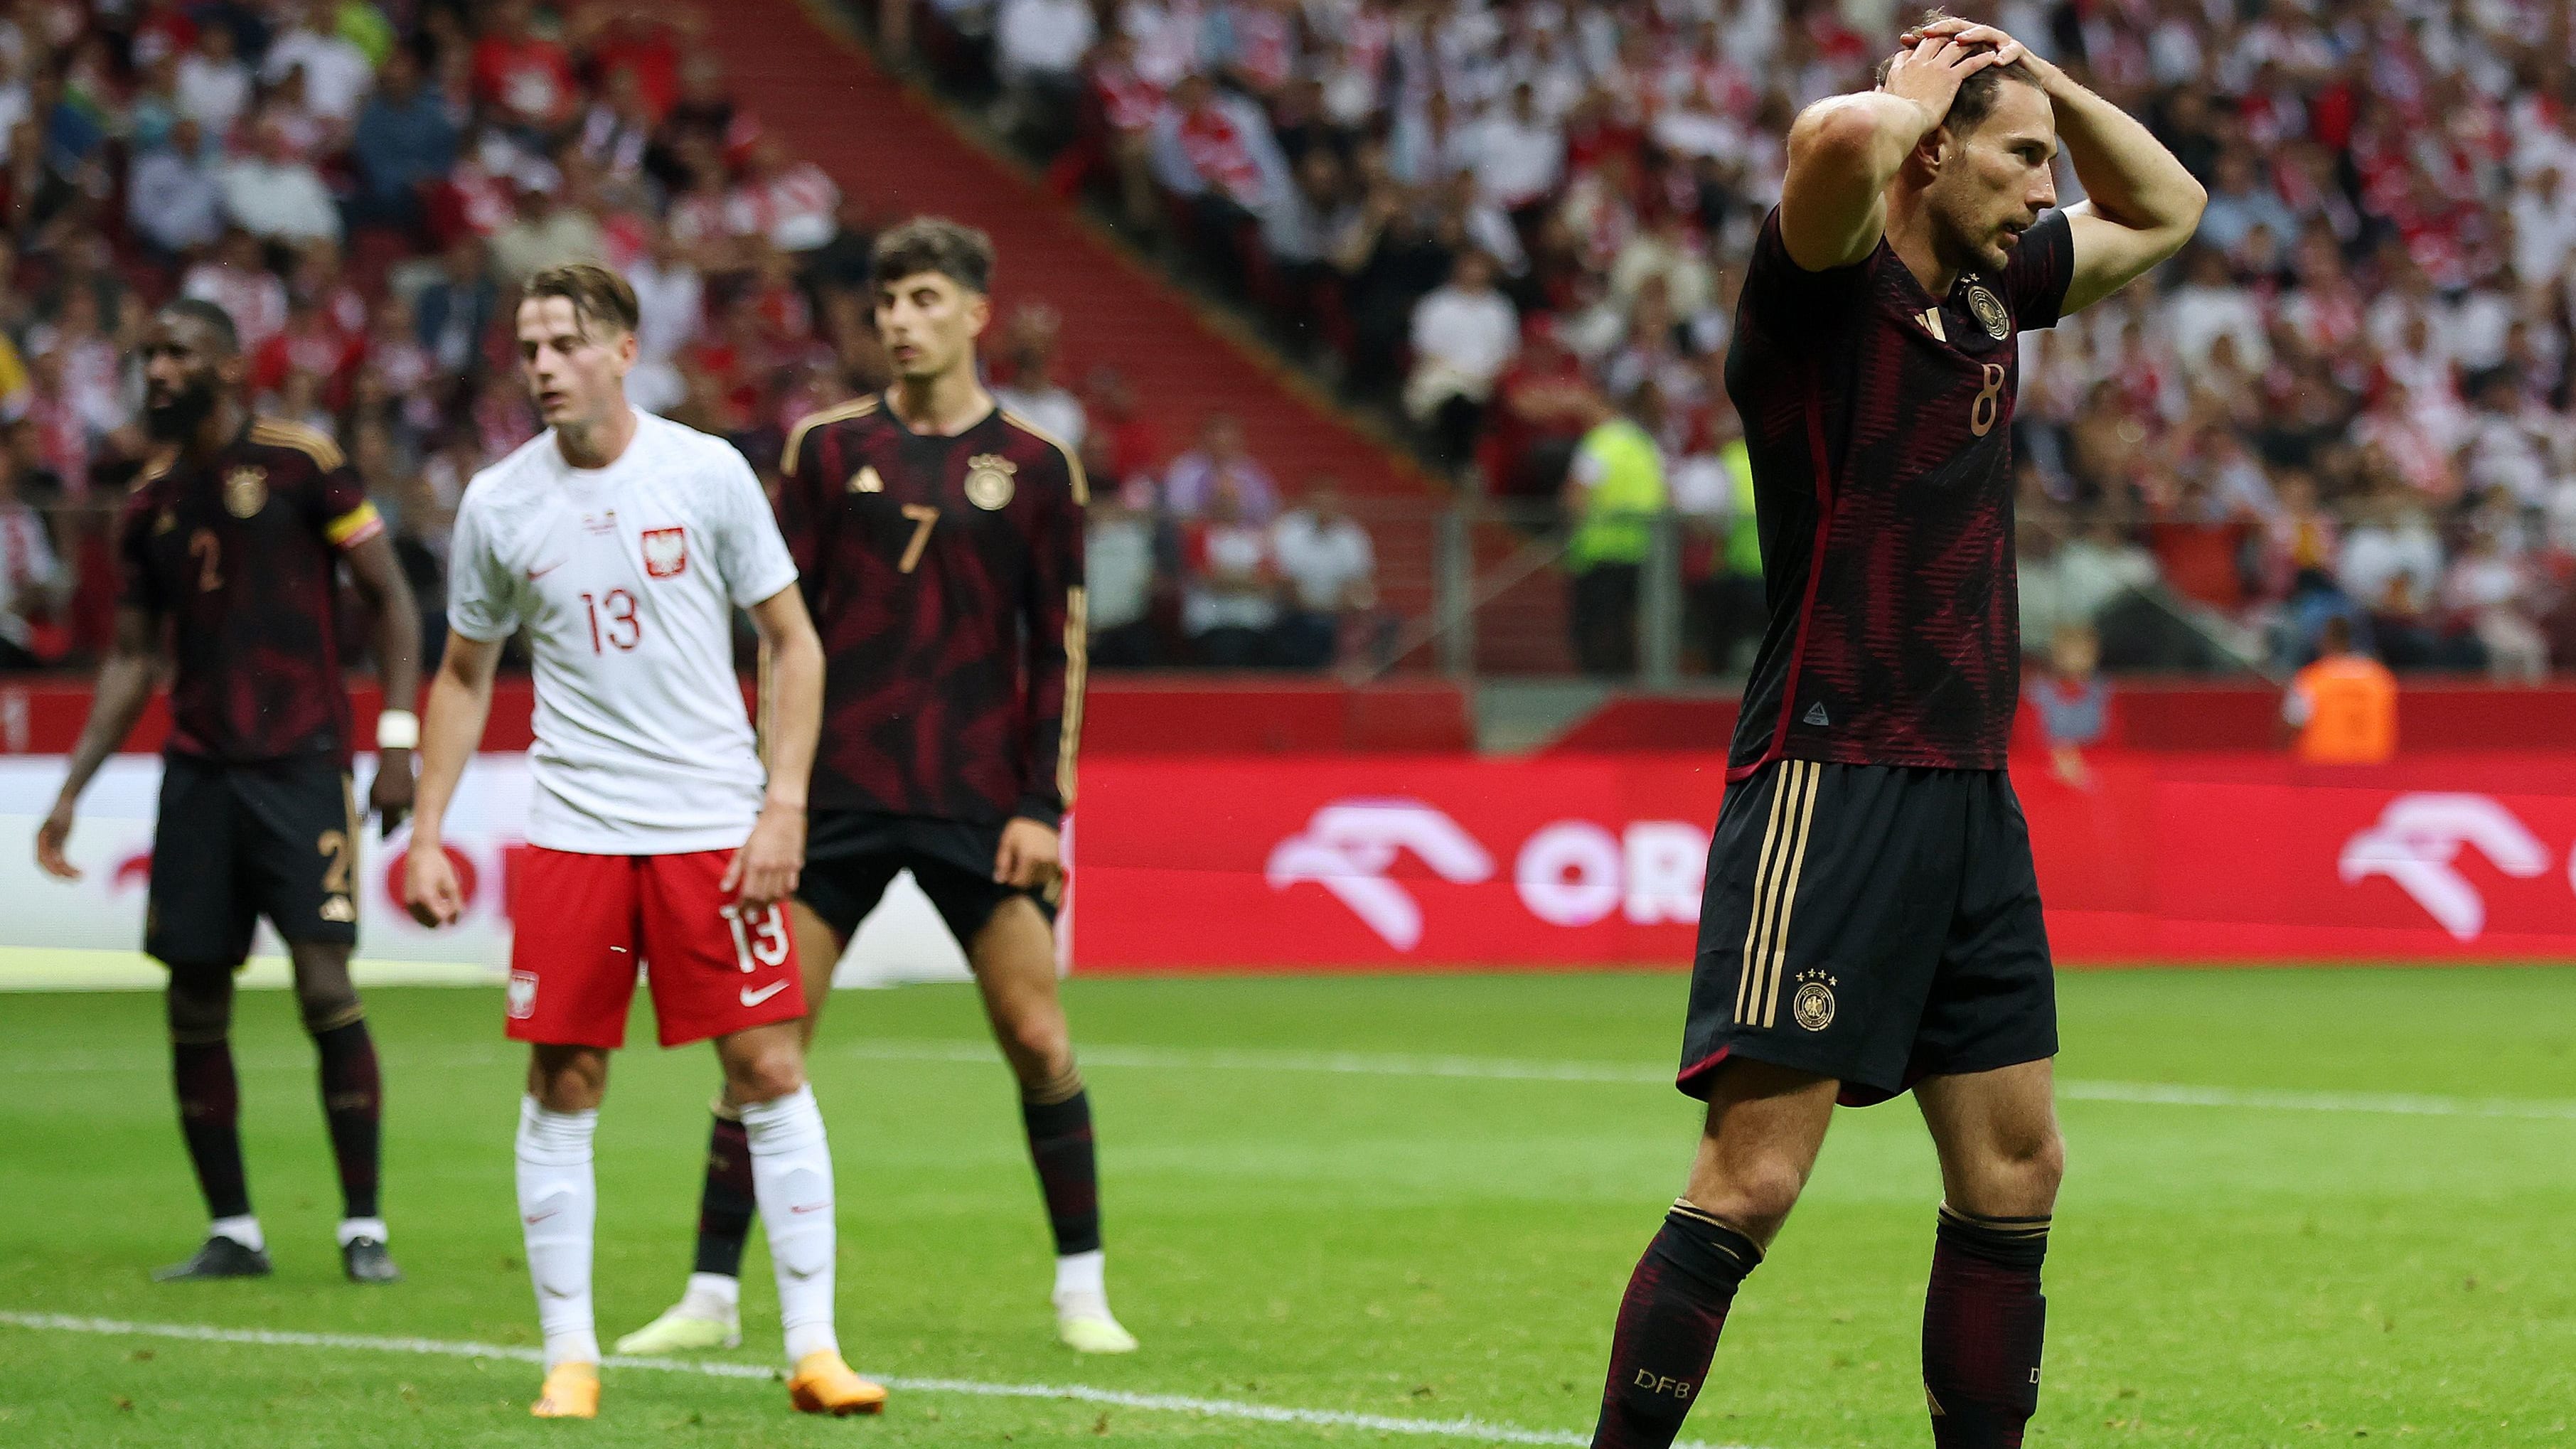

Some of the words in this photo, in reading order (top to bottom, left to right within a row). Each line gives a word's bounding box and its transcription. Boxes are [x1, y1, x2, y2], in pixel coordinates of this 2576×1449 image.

[1971, 363, 2005, 437] 8
[188, 529, 225, 592] 2
[898, 504, 940, 573] 7
[582, 588, 640, 656] 13
[317, 829, 351, 894] 2
[720, 904, 789, 973] 13
[1634, 1369, 1690, 1399] DFB
